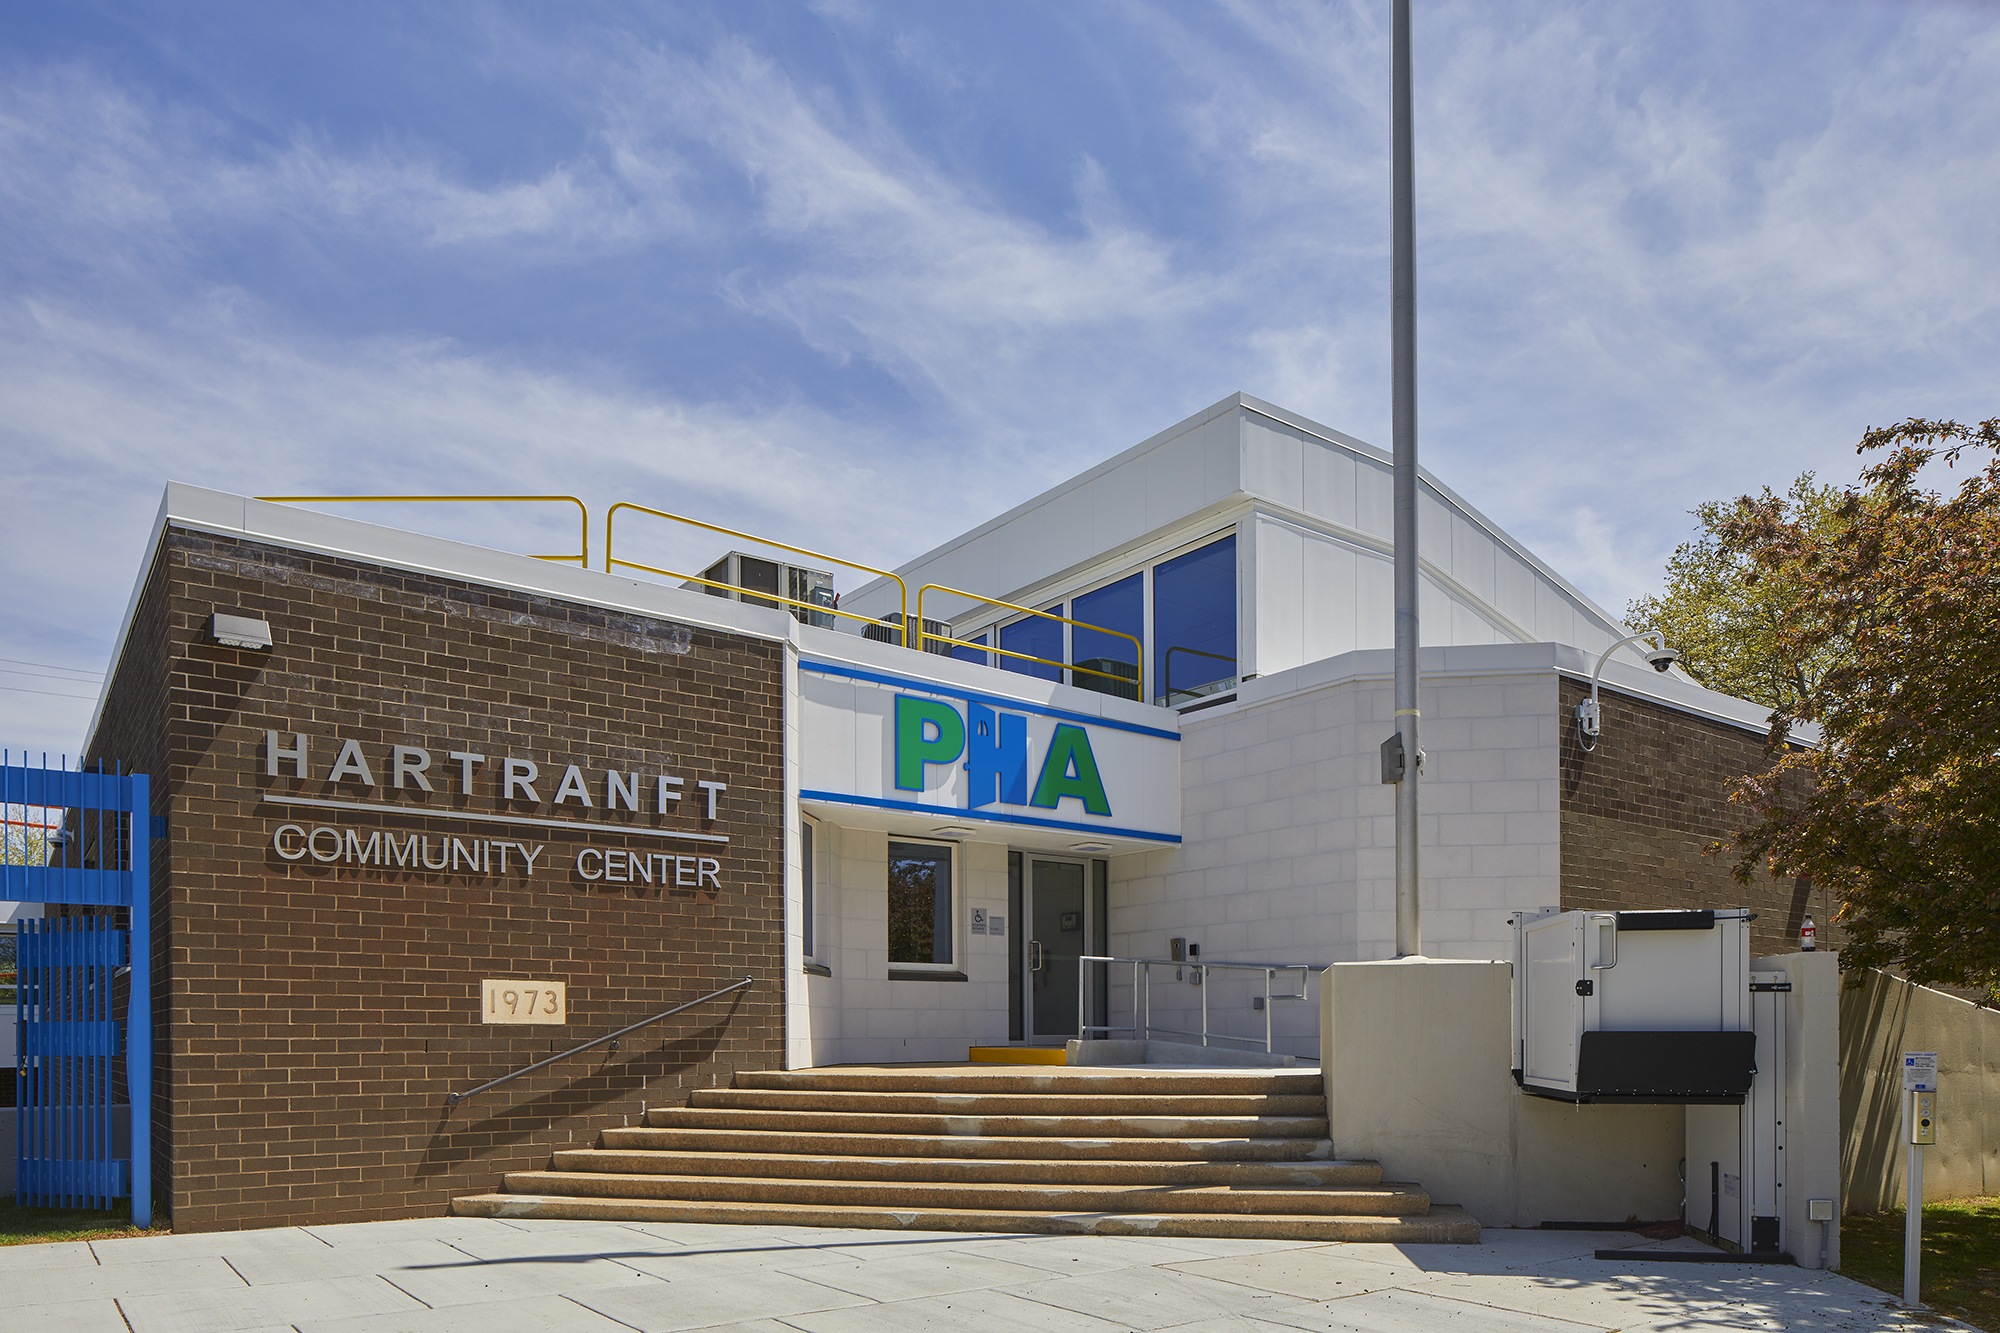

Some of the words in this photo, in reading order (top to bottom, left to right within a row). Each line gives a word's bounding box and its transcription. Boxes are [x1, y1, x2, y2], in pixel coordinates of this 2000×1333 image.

[265, 729, 727, 820] HARTRANFT
[894, 693, 1112, 817] PHA
[273, 824, 544, 875] COMMUNITY
[576, 848, 722, 889] CENTER
[490, 988, 559, 1015] 1973
